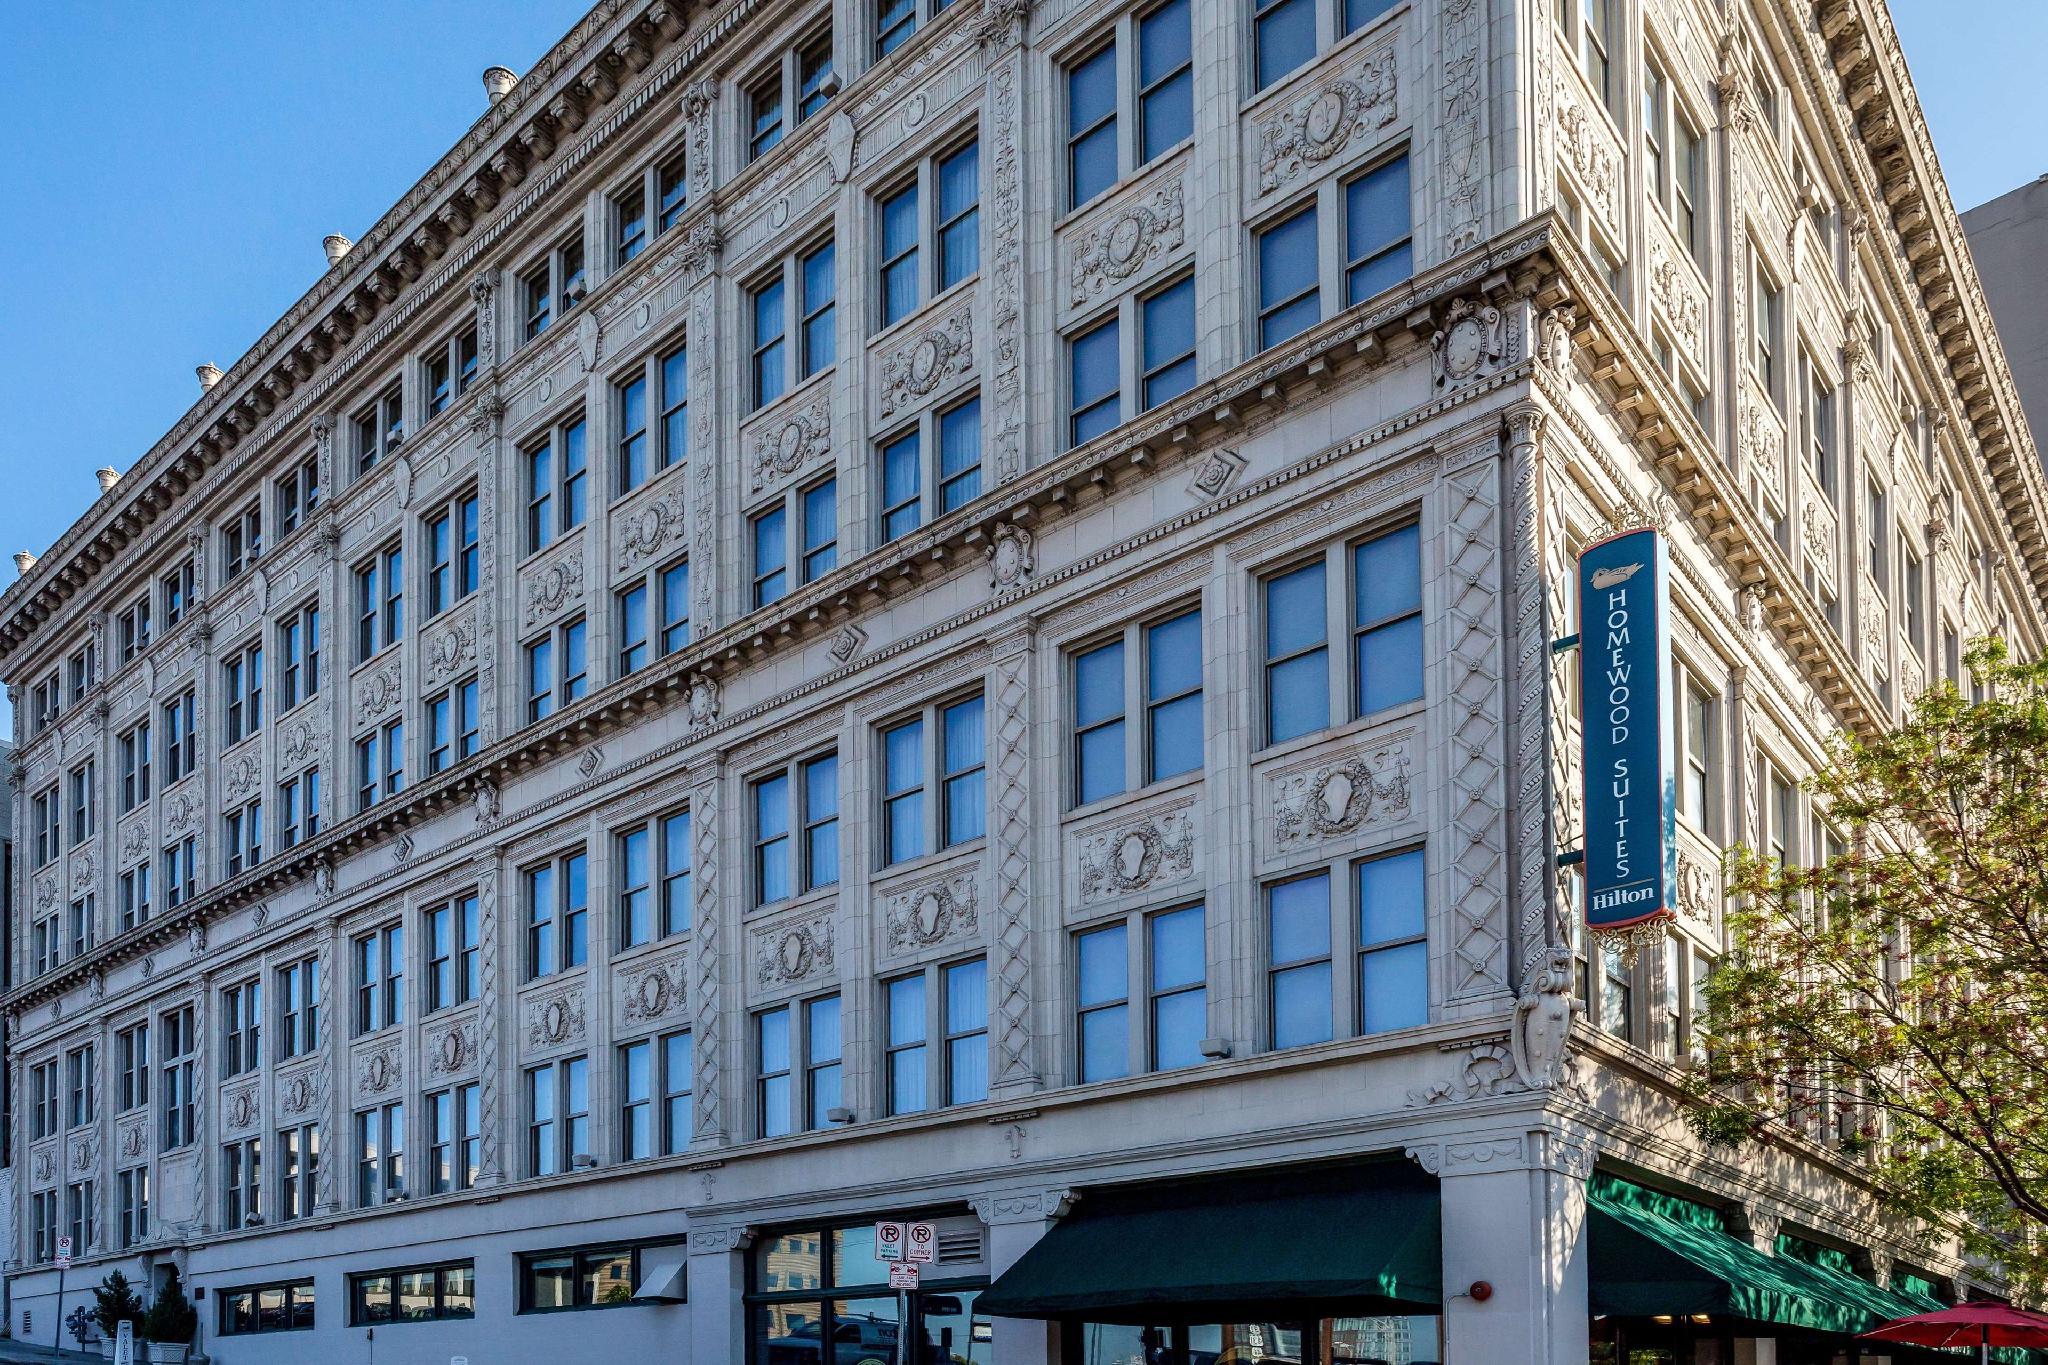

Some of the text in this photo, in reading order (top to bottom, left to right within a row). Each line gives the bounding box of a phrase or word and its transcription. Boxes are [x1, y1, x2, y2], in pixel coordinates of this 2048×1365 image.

[1606, 588, 1631, 878] HOMEWOOD SUITES
[1592, 887, 1655, 911] Hilton
